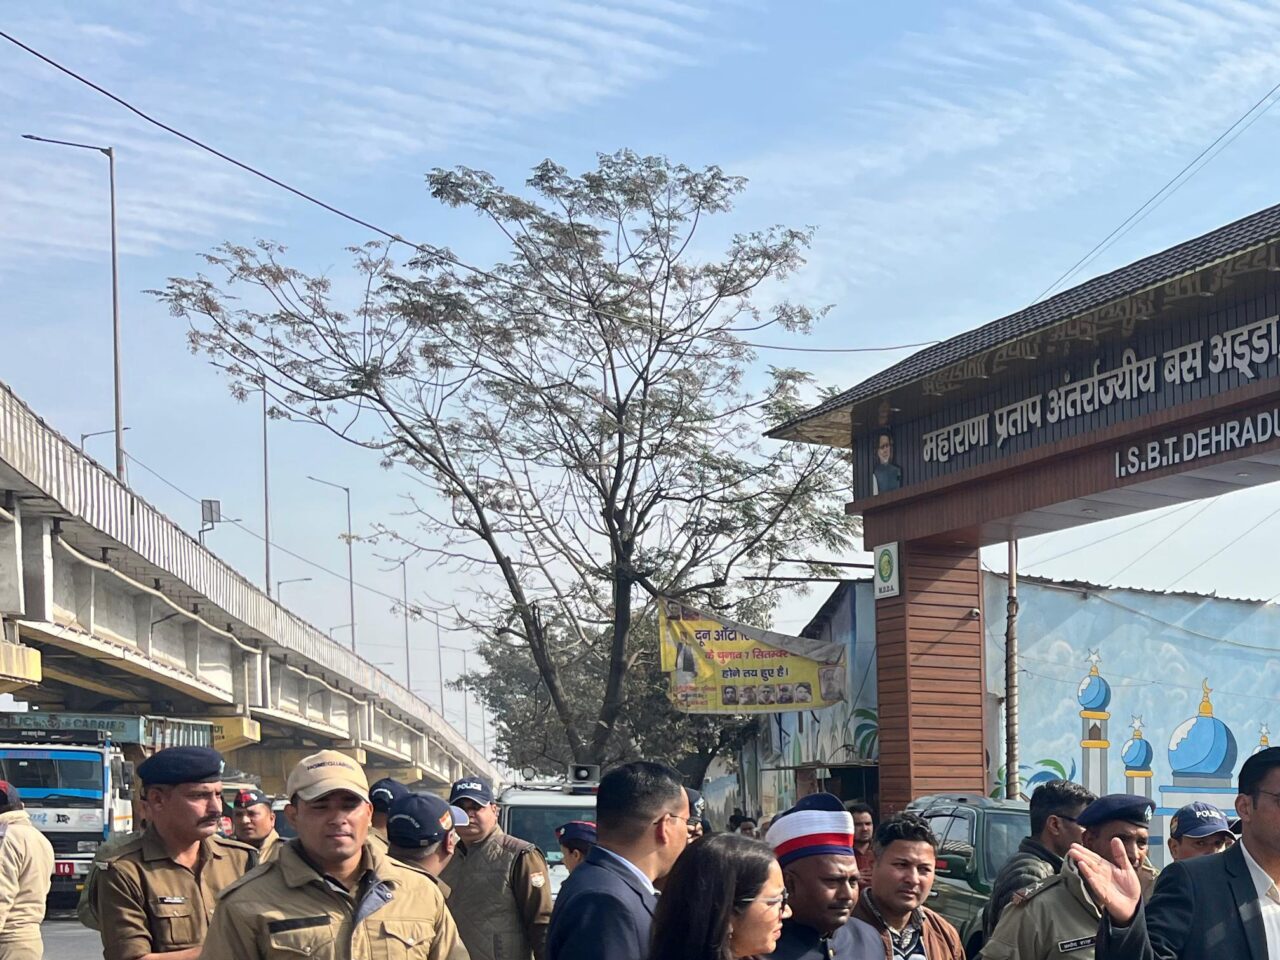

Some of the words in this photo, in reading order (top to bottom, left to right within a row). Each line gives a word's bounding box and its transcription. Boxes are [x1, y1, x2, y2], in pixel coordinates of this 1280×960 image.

[923, 413, 989, 462] महाराणा
[994, 394, 1041, 448] प्रताप
[1163, 340, 1203, 385] बस
[694, 629, 711, 647] दून
[721, 667, 740, 678] होने
[742, 669, 757, 677] तय
[457, 782, 482, 792] POLICE
[60, 863, 70, 873] 16
